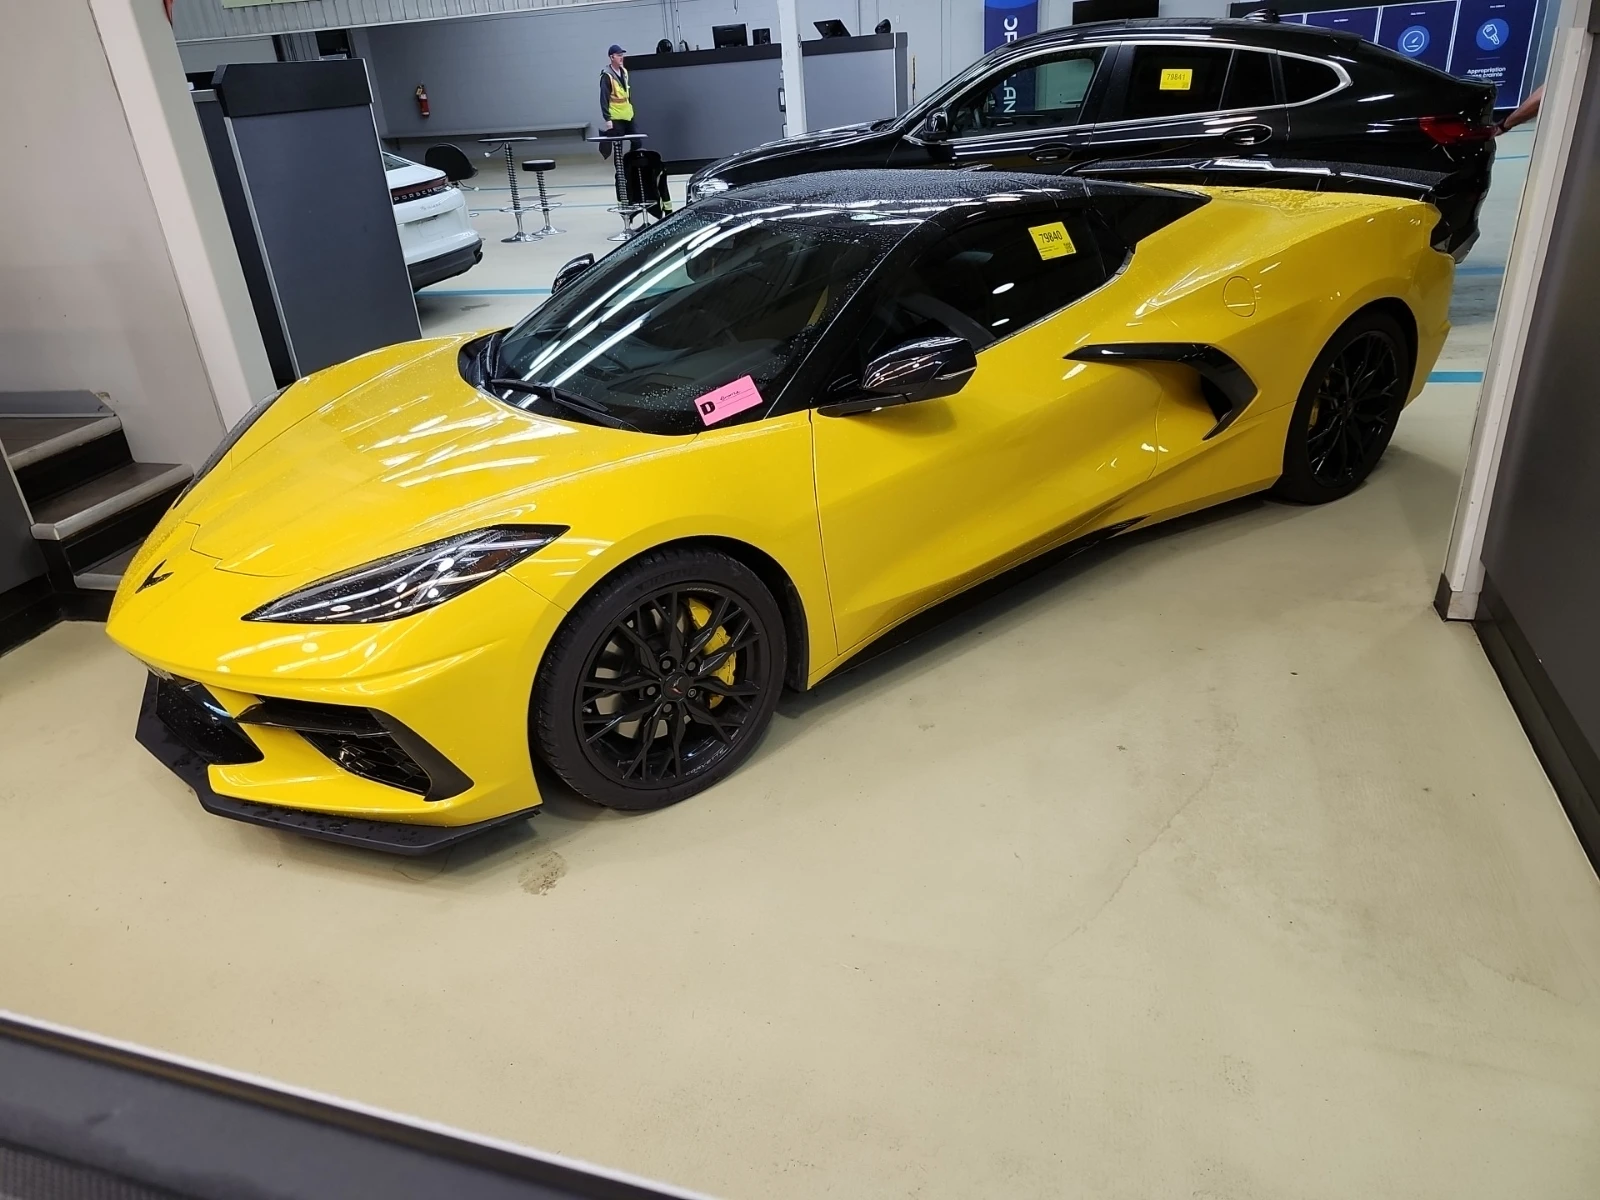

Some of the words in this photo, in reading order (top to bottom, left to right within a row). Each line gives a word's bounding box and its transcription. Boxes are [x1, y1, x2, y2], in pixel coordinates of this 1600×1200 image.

[1466, 67, 1506, 75] Appropriation
[1167, 73, 1186, 81] 79841
[1038, 230, 1063, 244] 79840
[700, 401, 716, 416] D
